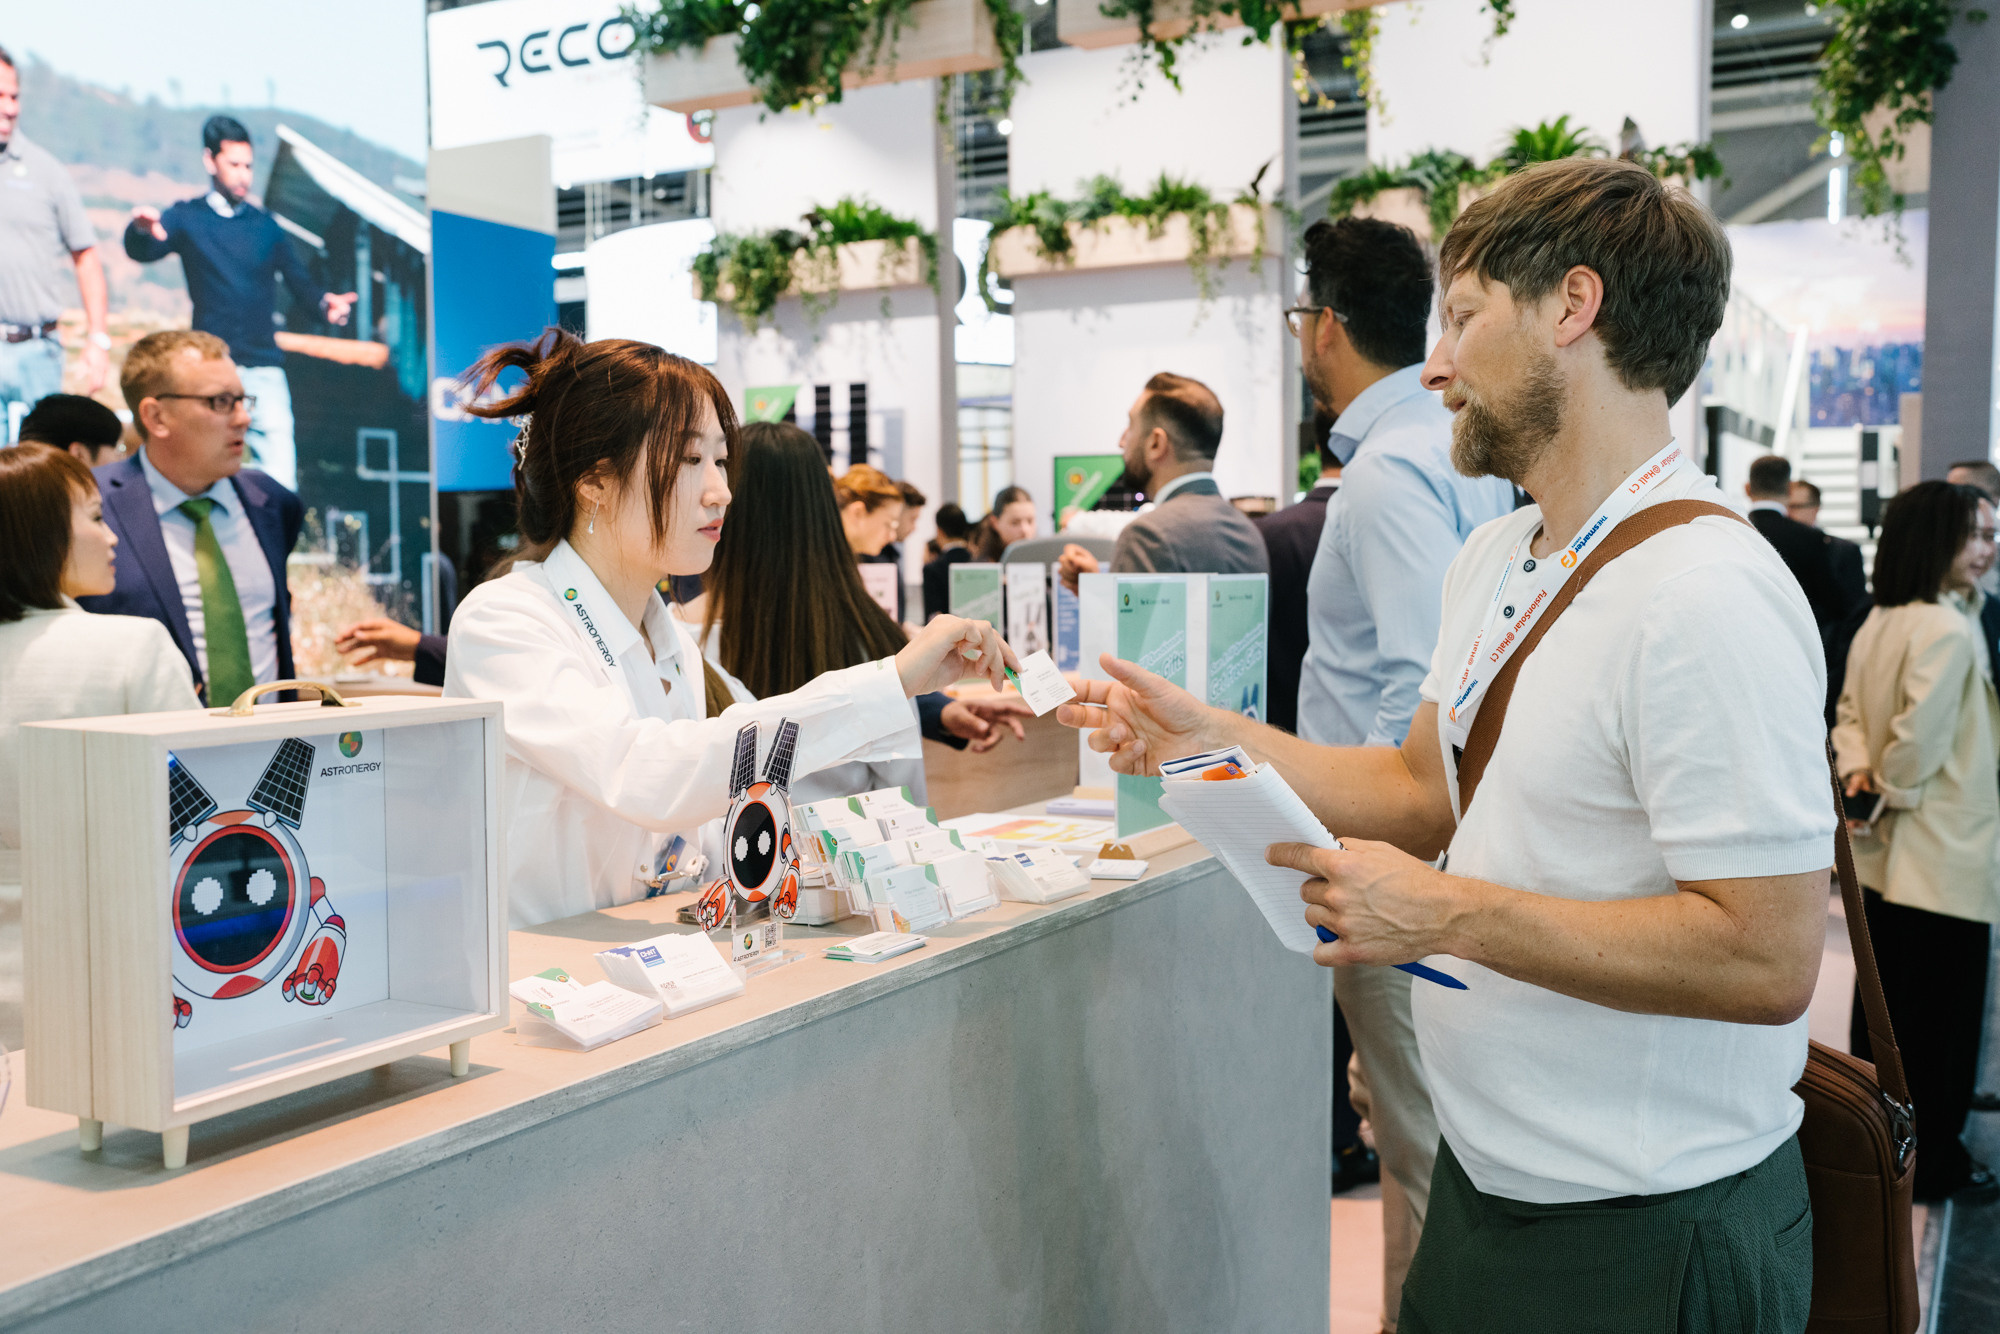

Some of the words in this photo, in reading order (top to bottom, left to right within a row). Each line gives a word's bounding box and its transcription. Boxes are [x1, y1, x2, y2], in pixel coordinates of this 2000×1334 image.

[1638, 464, 1661, 485] @Hall
[1628, 483, 1640, 494] C1
[1513, 589, 1548, 633] FusionSolar
[573, 603, 617, 667] ASTRONERGY
[1496, 632, 1515, 654] @Hall
[1490, 652, 1500, 663] C1
[320, 762, 382, 777] ASTRONERGY
